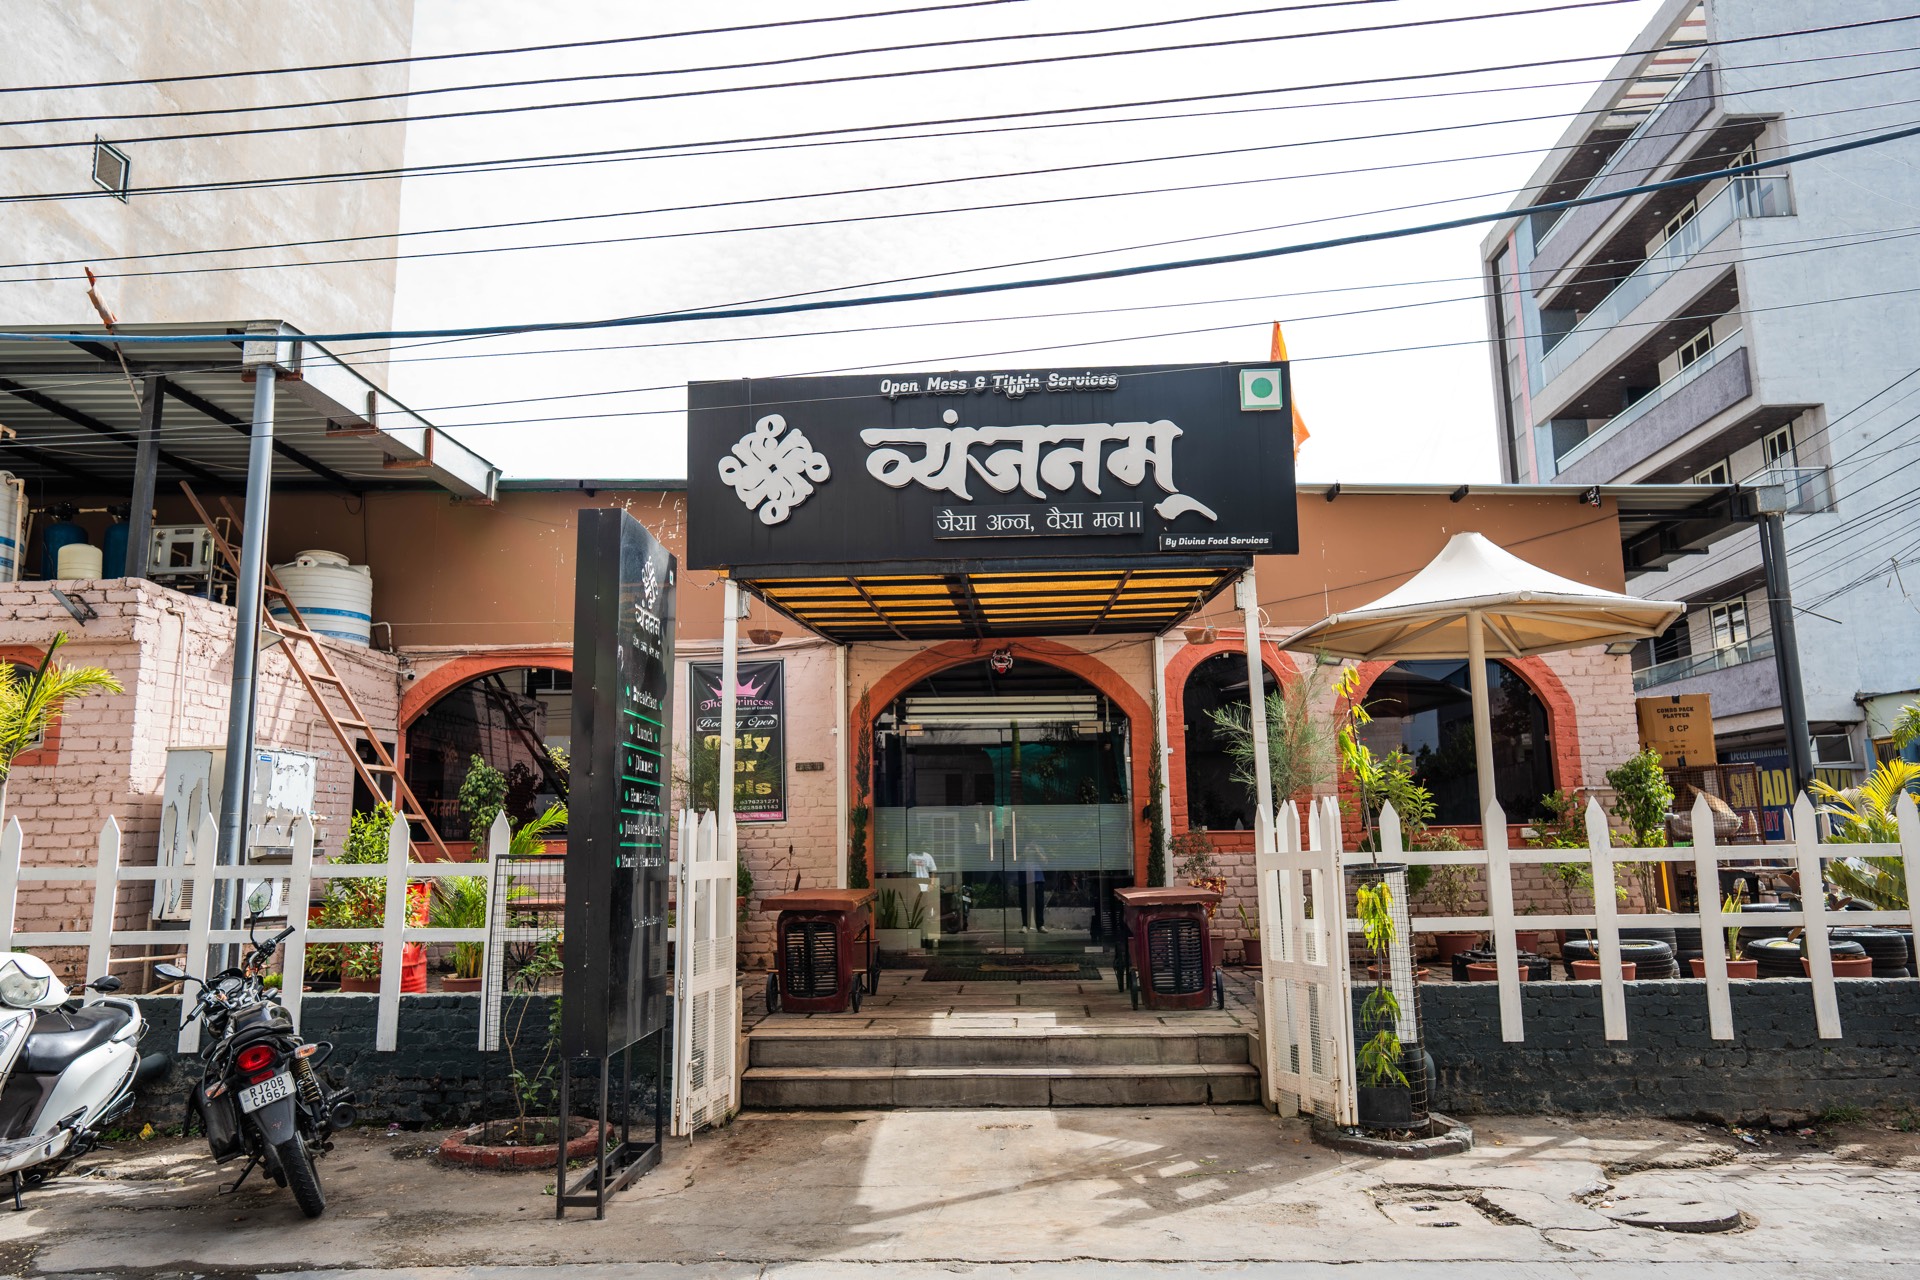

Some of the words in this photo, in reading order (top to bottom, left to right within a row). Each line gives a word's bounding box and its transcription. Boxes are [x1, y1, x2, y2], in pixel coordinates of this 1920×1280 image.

[880, 379, 919, 394] Open
[927, 377, 967, 391] Mess
[974, 376, 986, 389] &
[992, 374, 1040, 394] Tiffin
[1047, 371, 1118, 387] Services
[860, 409, 1218, 521] व्यंजनम्
[936, 508, 977, 531] जैसा
[1046, 507, 1084, 529] वैसा
[1165, 537, 1177, 547] By
[1178, 537, 1206, 545] Divine
[1207, 537, 1229, 545] Food
[1230, 536, 1269, 544] Services
[633, 686, 658, 710] Breakfast
[748, 716, 776, 728] Open
[636, 723, 653, 743] Lunch
[635, 755, 653, 774] Dinner
[250, 1077, 284, 1098] RJ20B
[253, 1086, 288, 1107] C4962
